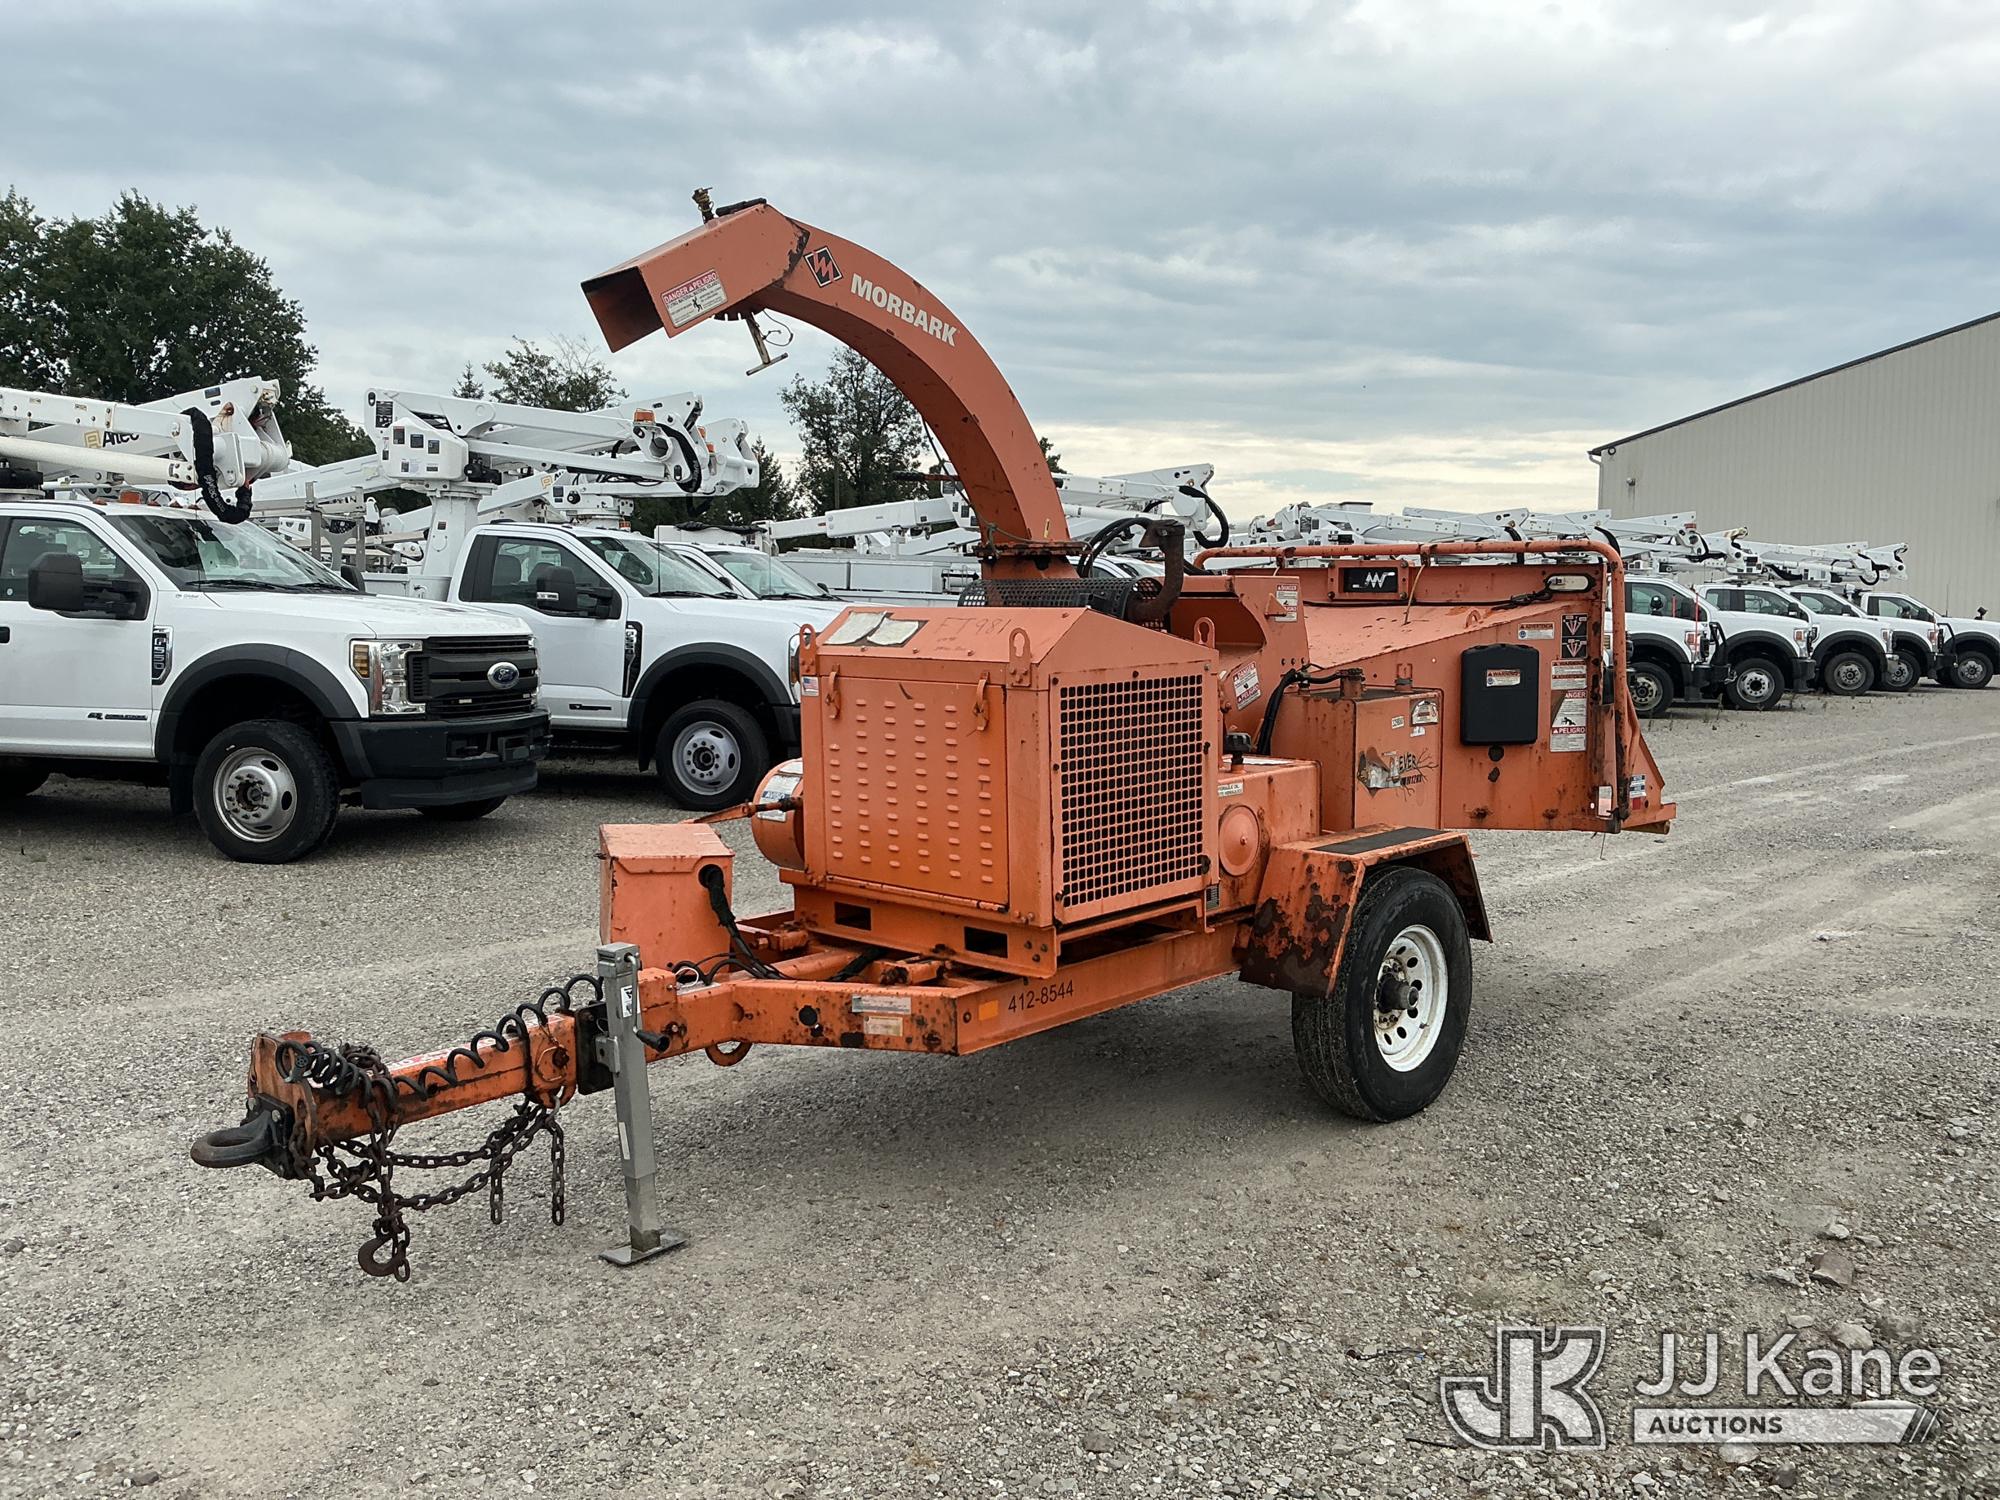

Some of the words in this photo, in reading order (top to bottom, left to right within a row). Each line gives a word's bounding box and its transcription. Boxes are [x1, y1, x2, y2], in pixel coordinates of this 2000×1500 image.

[663, 286, 689, 304] DANGER
[691, 272, 717, 289] PELIGRO
[851, 273, 957, 347] MORBARK
[1008, 980, 1074, 1013] 412-8544
